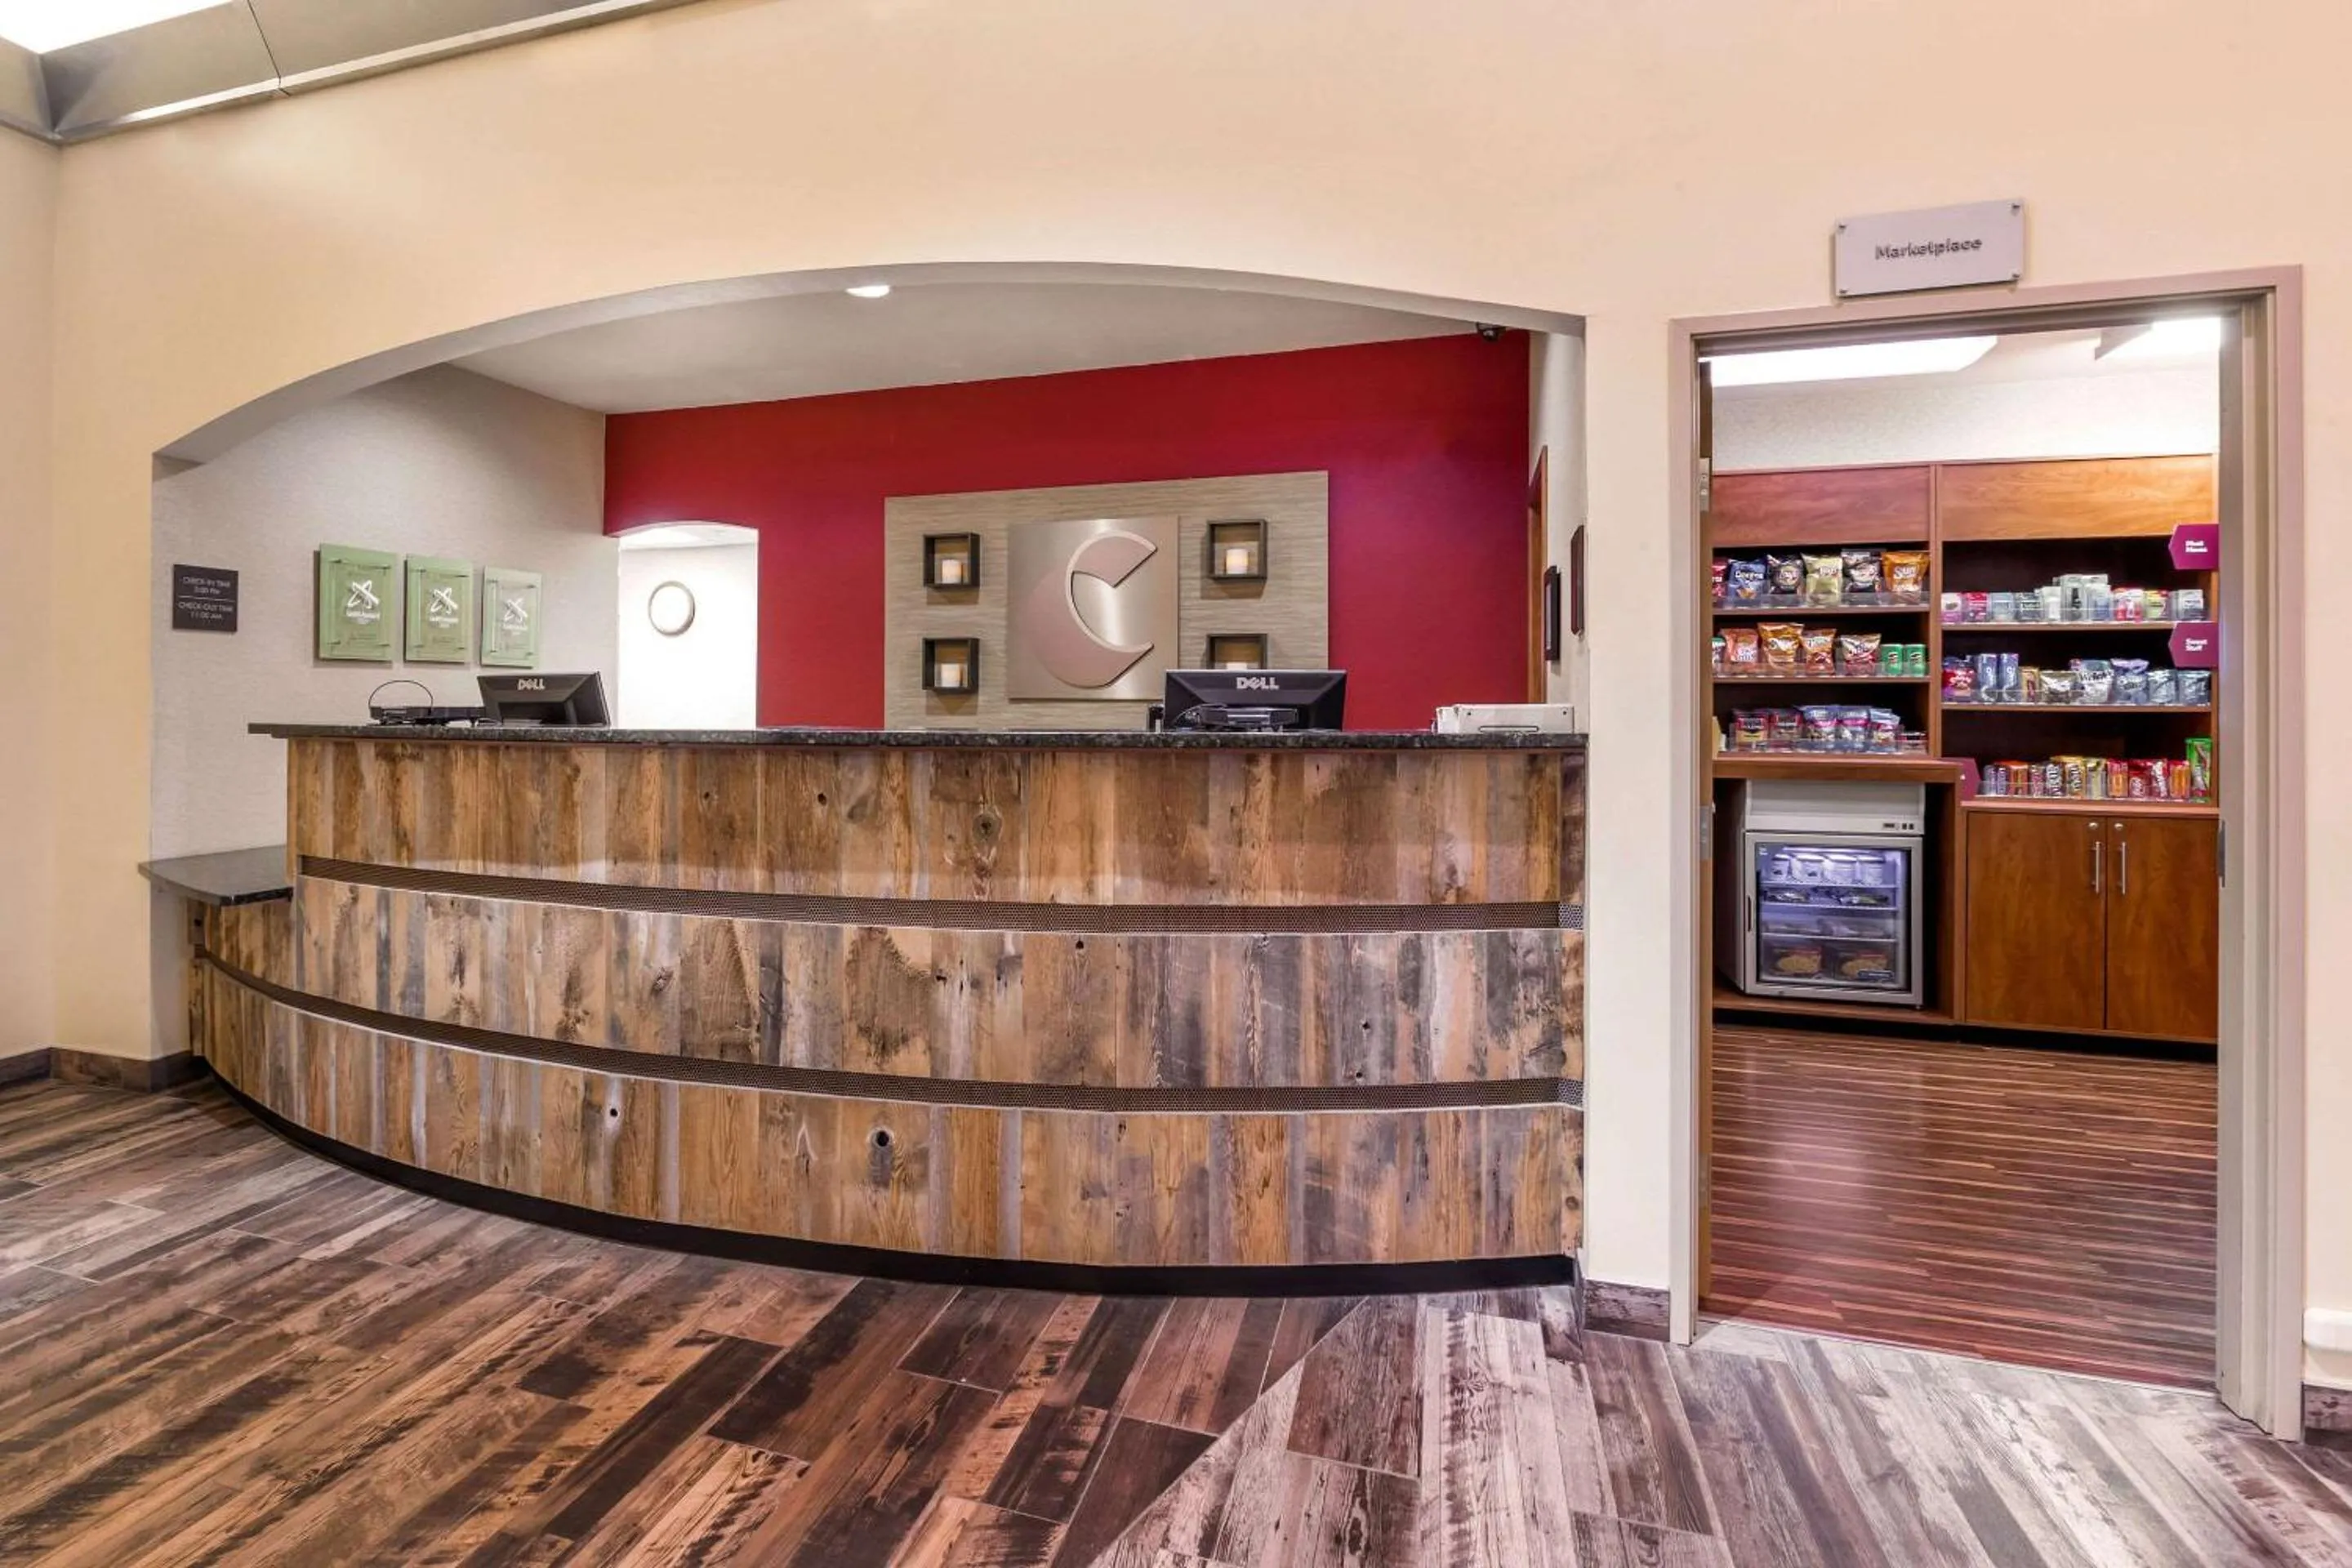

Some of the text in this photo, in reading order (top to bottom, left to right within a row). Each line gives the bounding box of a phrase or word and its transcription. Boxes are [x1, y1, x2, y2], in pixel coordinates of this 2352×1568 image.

[1875, 238, 1983, 260] Marketplace
[518, 678, 546, 690] DELL
[1236, 677, 1280, 689] DELL
